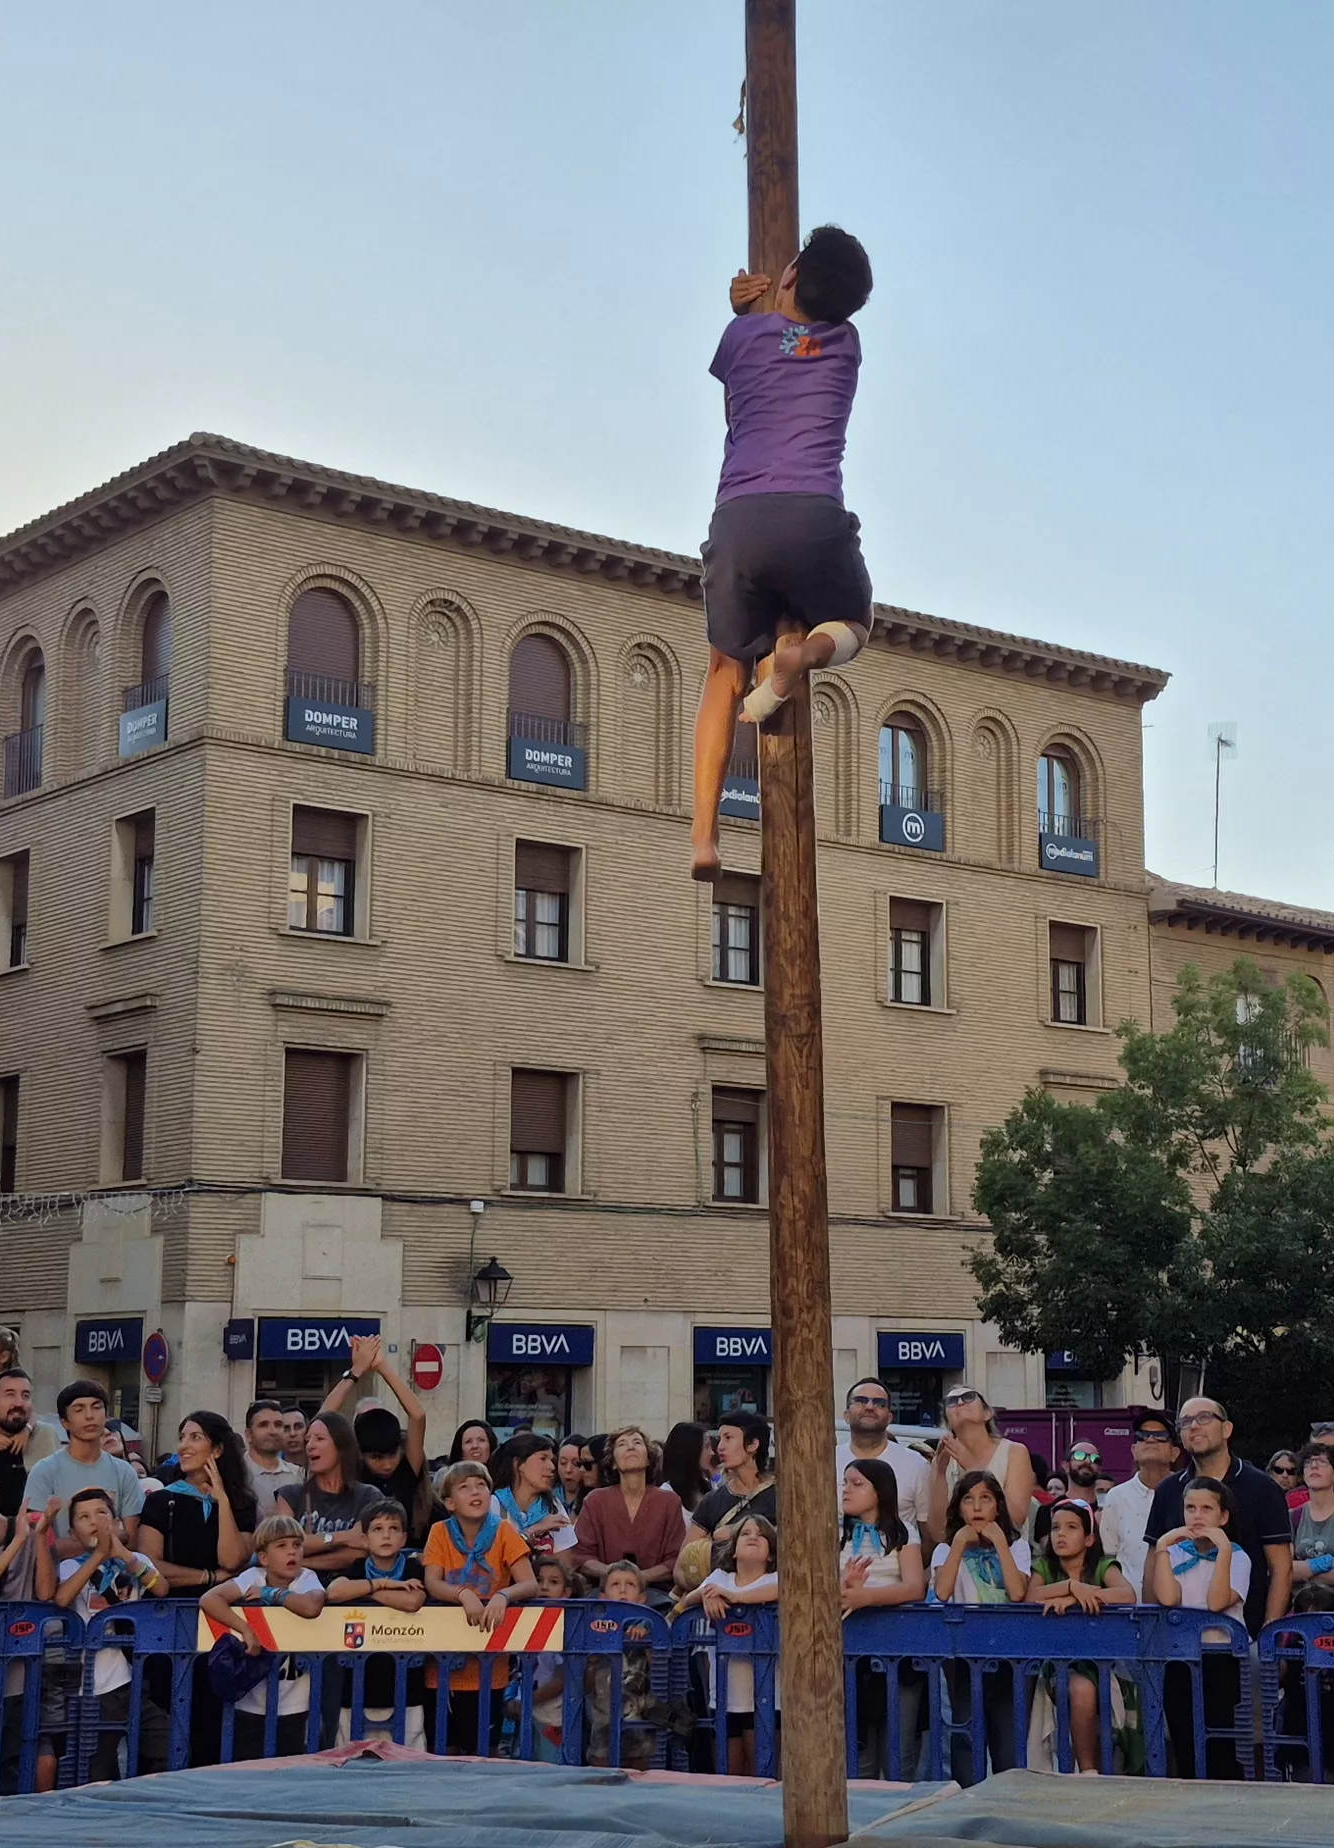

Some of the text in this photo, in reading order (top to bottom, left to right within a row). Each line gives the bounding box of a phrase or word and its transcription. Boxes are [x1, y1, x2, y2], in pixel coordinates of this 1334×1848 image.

[127, 712, 158, 734] DOMPER
[304, 708, 358, 731] DOMPER
[306, 724, 357, 740] ARQUITECTURA
[525, 748, 573, 768] DOMPER
[526, 762, 572, 777] ARQUITECTURA
[88, 1328, 125, 1352] BBVA
[229, 1333, 247, 1345] BBVA
[287, 1327, 352, 1351] BBVA
[512, 1333, 570, 1355] BBVA
[716, 1336, 768, 1356] BBVA
[898, 1340, 946, 1360] BBVA
[371, 1624, 424, 1636] Monzón
[596, 1621, 616, 1631] JSP
[729, 1624, 751, 1634] JSP
